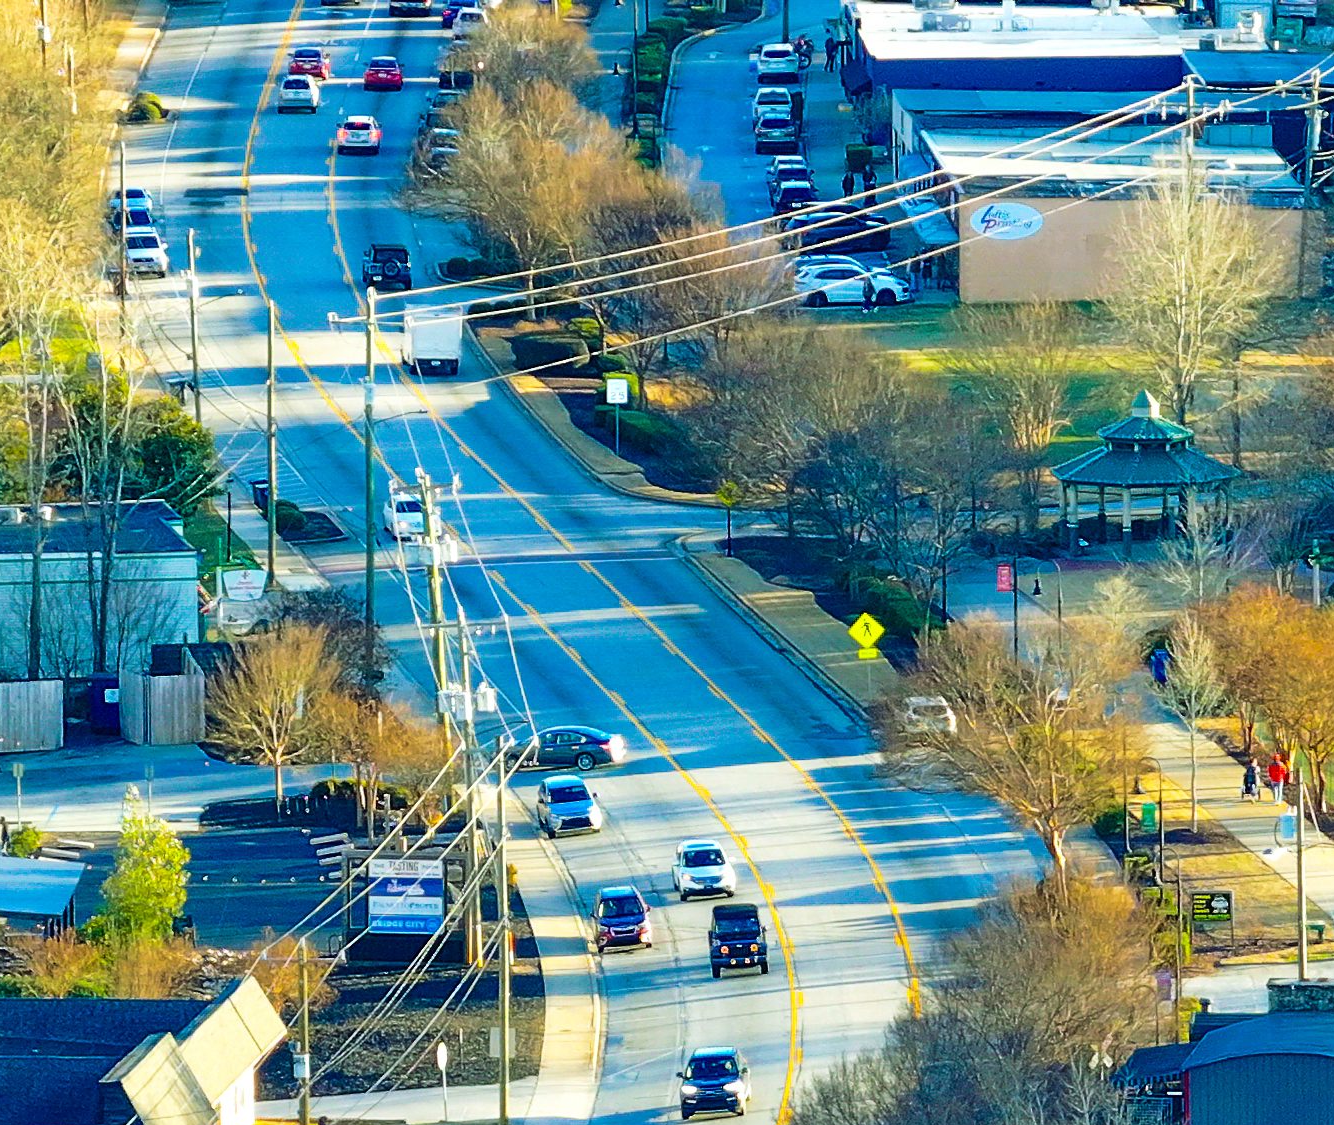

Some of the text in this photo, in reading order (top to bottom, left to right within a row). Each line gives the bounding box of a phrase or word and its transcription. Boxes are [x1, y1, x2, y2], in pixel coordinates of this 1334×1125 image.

[611, 391, 625, 400] 25
[389, 860, 419, 872] TASTING
[405, 920, 426, 929] CITY
